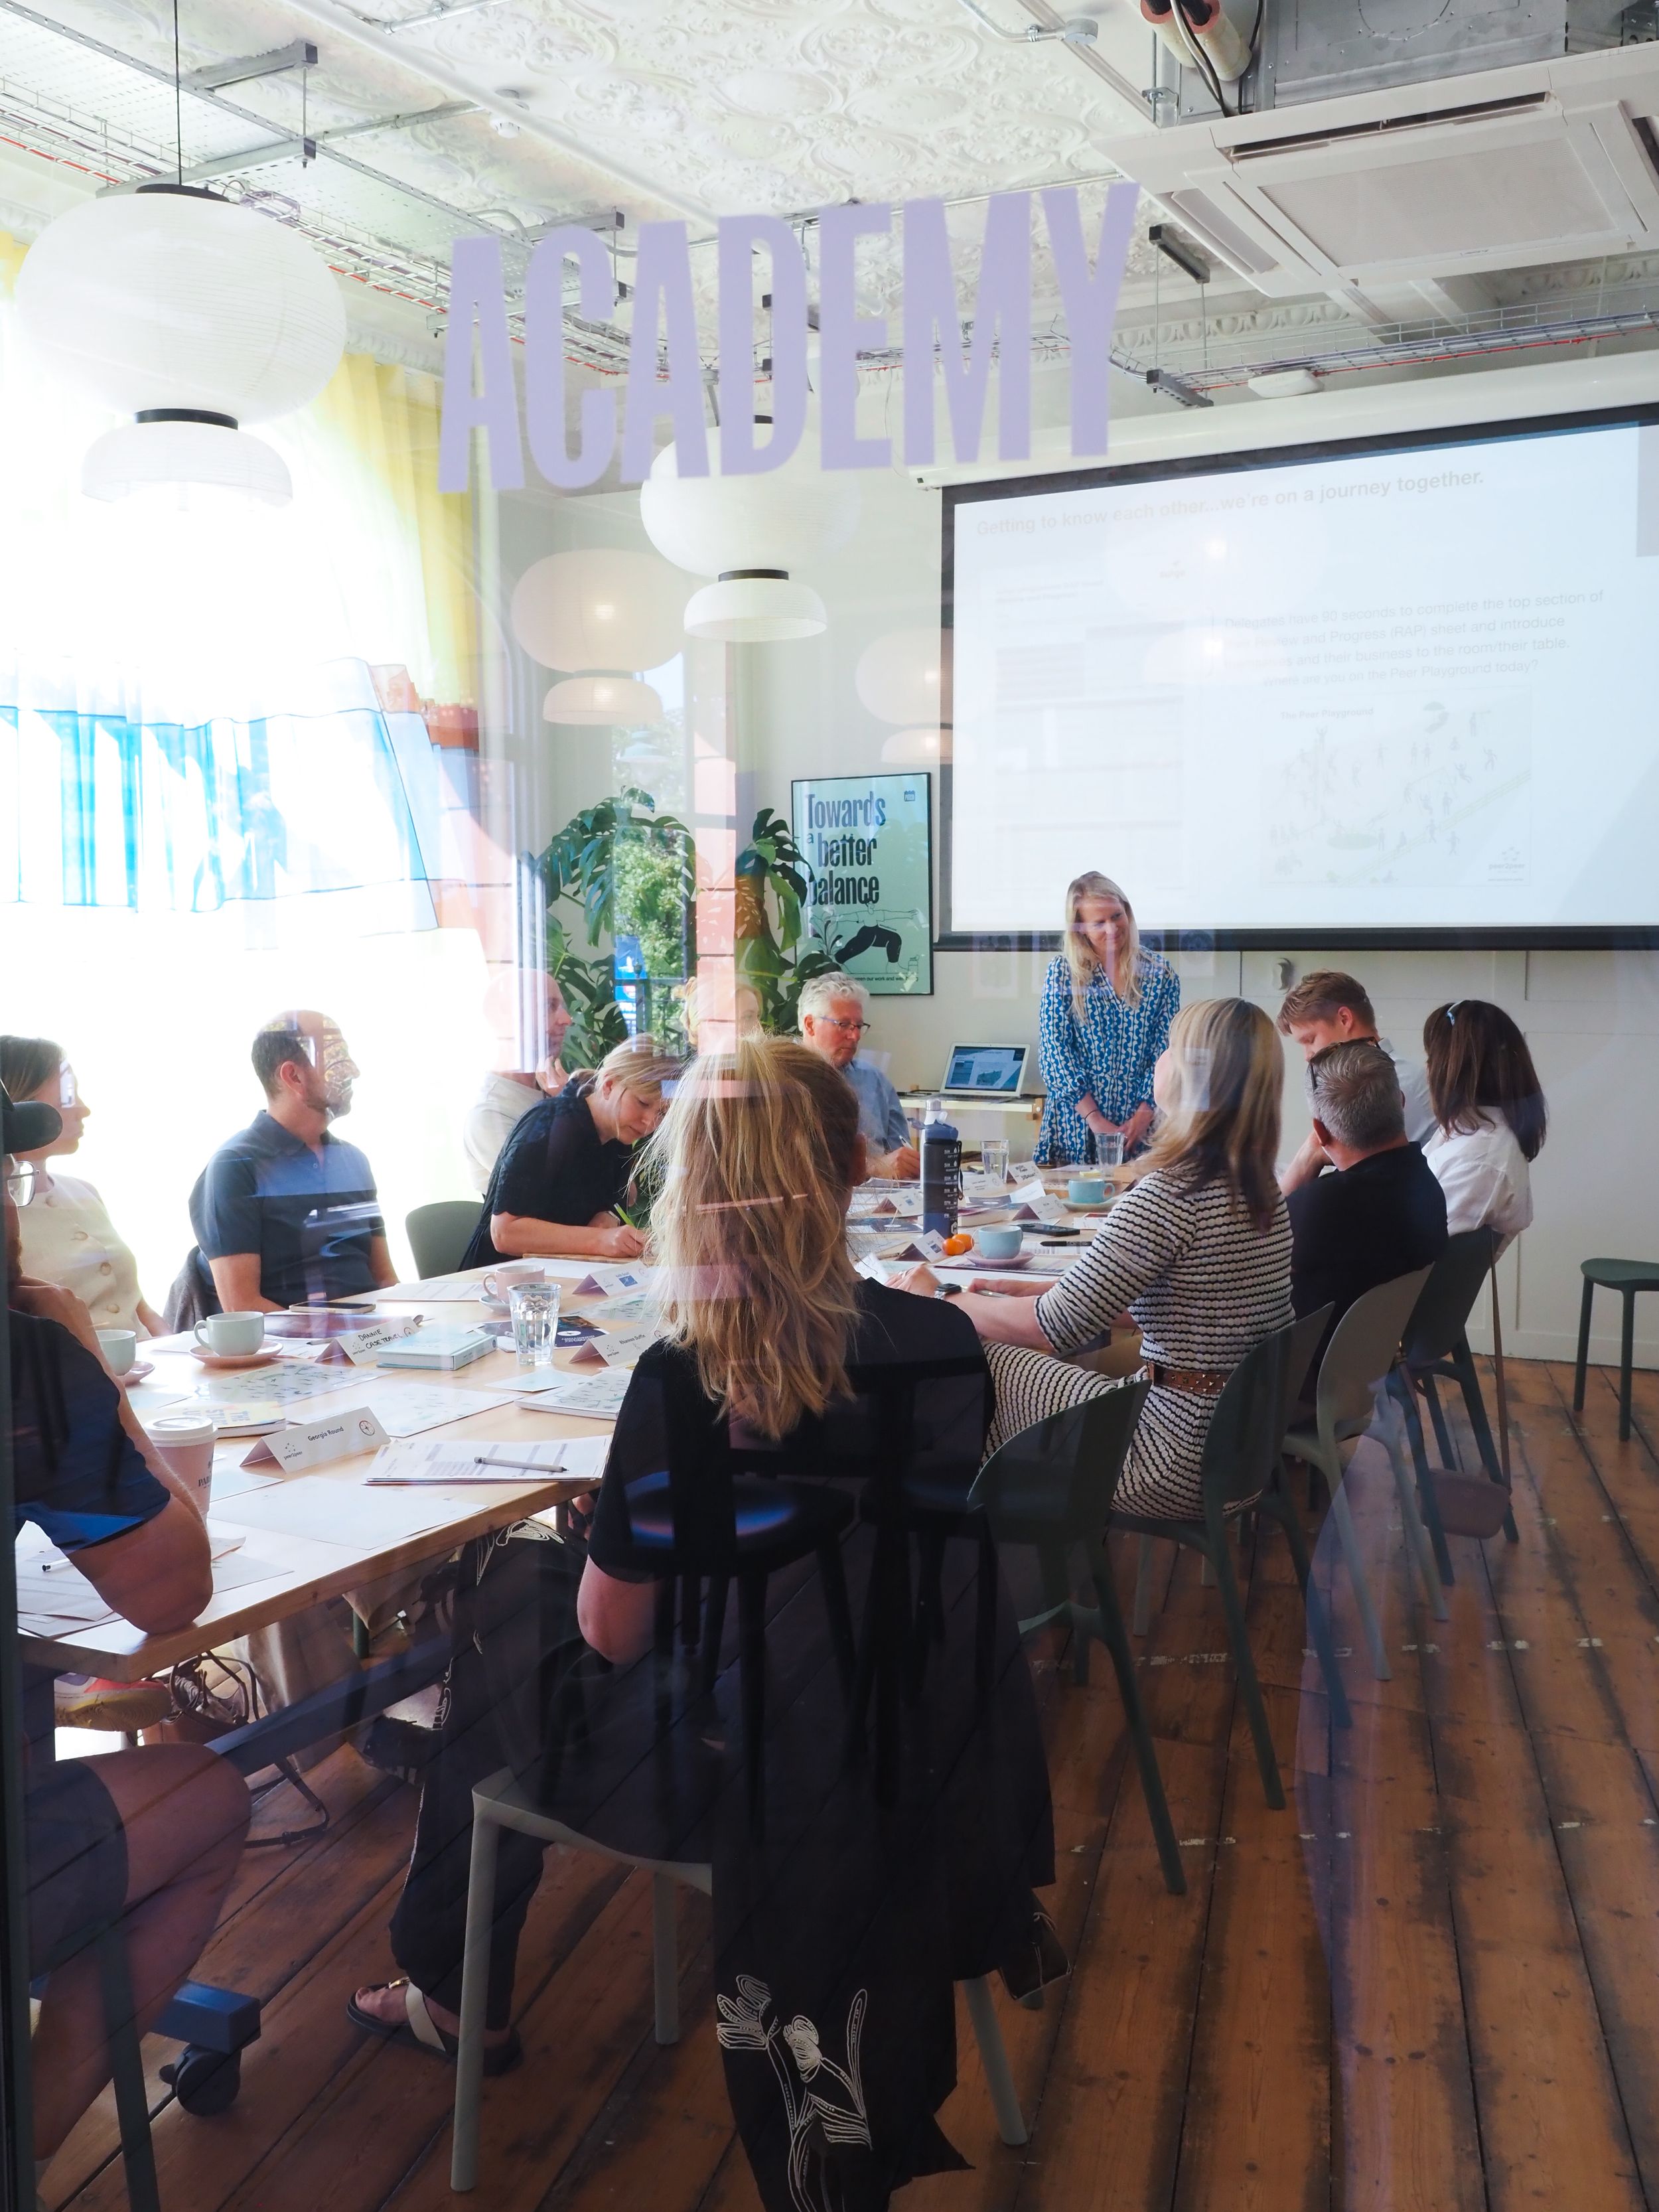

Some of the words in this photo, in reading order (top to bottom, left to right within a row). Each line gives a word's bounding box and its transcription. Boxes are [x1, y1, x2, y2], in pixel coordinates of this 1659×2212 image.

[439, 183, 1141, 493] ACADEMY
[976, 518, 1035, 536] Getting
[1041, 516, 1056, 530] to
[1062, 510, 1108, 528] know
[1113, 503, 1154, 521] each
[1275, 490, 1297, 504] on
[1303, 490, 1314, 501] a
[1319, 480, 1391, 503] journey
[1397, 471, 1484, 493] together.
[1224, 613, 1285, 630] Delegates
[1289, 611, 1319, 625] have
[1322, 610, 1338, 622] 90
[1342, 605, 1396, 621] seconds
[1400, 606, 1413, 616] to
[1416, 599, 1479, 615] complete
[1483, 598, 1504, 610] the
[1508, 595, 1530, 609] top
[1535, 591, 1585, 606] section
[1590, 589, 1604, 602] of
[1303, 632, 1326, 644] and
[1330, 629, 1386, 644] Progress
[1391, 624, 1426, 639] (RAP)
[1431, 622, 1466, 636] sheet
[1471, 619, 1496, 632] and
[1500, 615, 1565, 630] introduce
[1297, 652, 1319, 666] and
[1324, 650, 1352, 664] their
[1356, 647, 1413, 662] business
[1417, 646, 1429, 657] to
[1434, 644, 1455, 656] the
[1459, 639, 1529, 655] room/their
[1533, 636, 1570, 650] table.
[1263, 674, 1299, 688] Where
[1302, 674, 1321, 685] are
[1324, 673, 1345, 686] you
[1349, 671, 1364, 681] on
[1368, 668, 1387, 680] the
[1390, 666, 1417, 679] Peer
[1421, 662, 1492, 680] Playground
[1496, 658, 1539, 675] today?
[1280, 711, 1297, 721] The
[1299, 710, 1319, 719] Peer
[1322, 707, 1375, 719] Playground
[806, 791, 887, 830] Towards
[806, 833, 814, 844] a
[818, 834, 877, 867] better
[808, 870, 880, 907] balance
[358, 1329, 383, 1342] DANNIE
[307, 1431, 328, 1442] Georgia
[327, 1426, 344, 1436] Round
